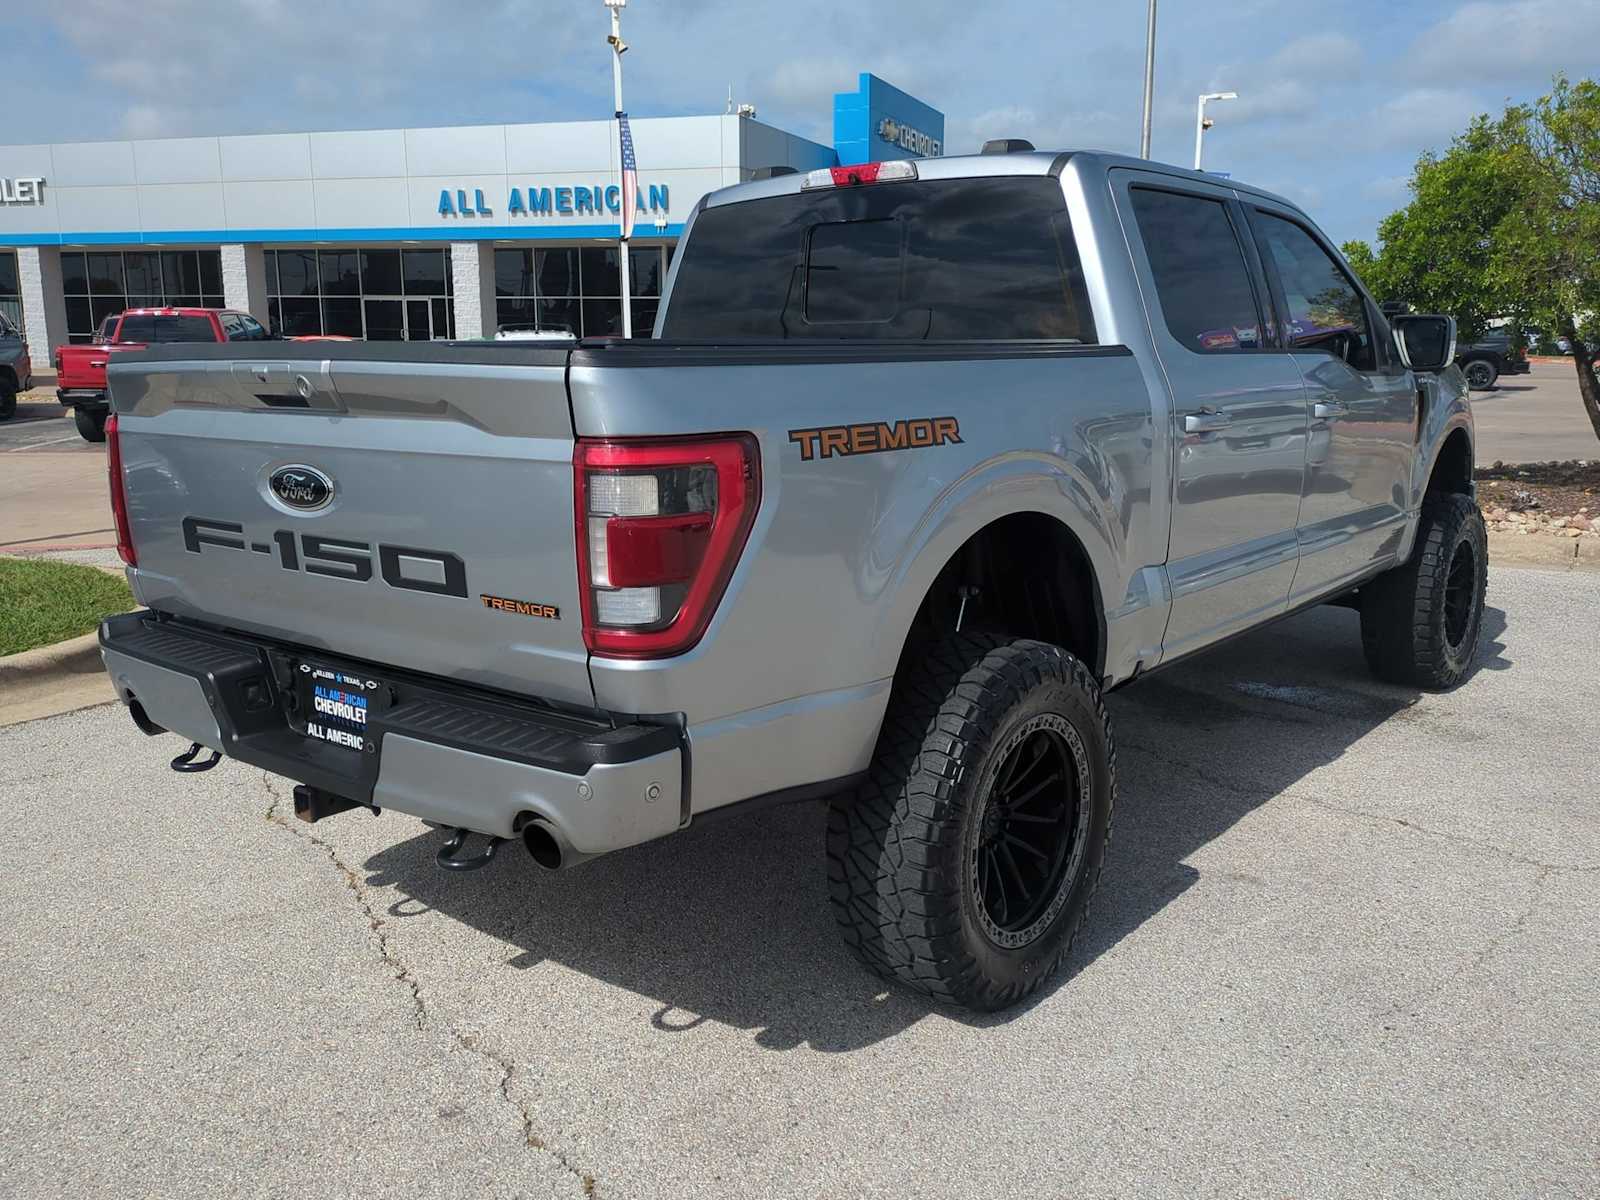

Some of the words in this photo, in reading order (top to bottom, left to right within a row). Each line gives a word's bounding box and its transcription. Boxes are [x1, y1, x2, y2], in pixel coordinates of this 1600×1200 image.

[900, 125, 943, 157] CHEVROLET
[0, 177, 46, 204] LET
[438, 188, 491, 216] ALL
[508, 184, 668, 215] AMERICAN
[788, 416, 965, 461] TREMOR
[280, 473, 315, 502] Ford
[182, 516, 468, 599] F-150
[480, 595, 560, 619] TREMOR
[343, 675, 361, 687] TEXAS
[314, 685, 328, 699] ALL
[329, 688, 367, 708] AMERICAN
[314, 696, 367, 724] CHEVROLET
[307, 722, 325, 739] ALL
